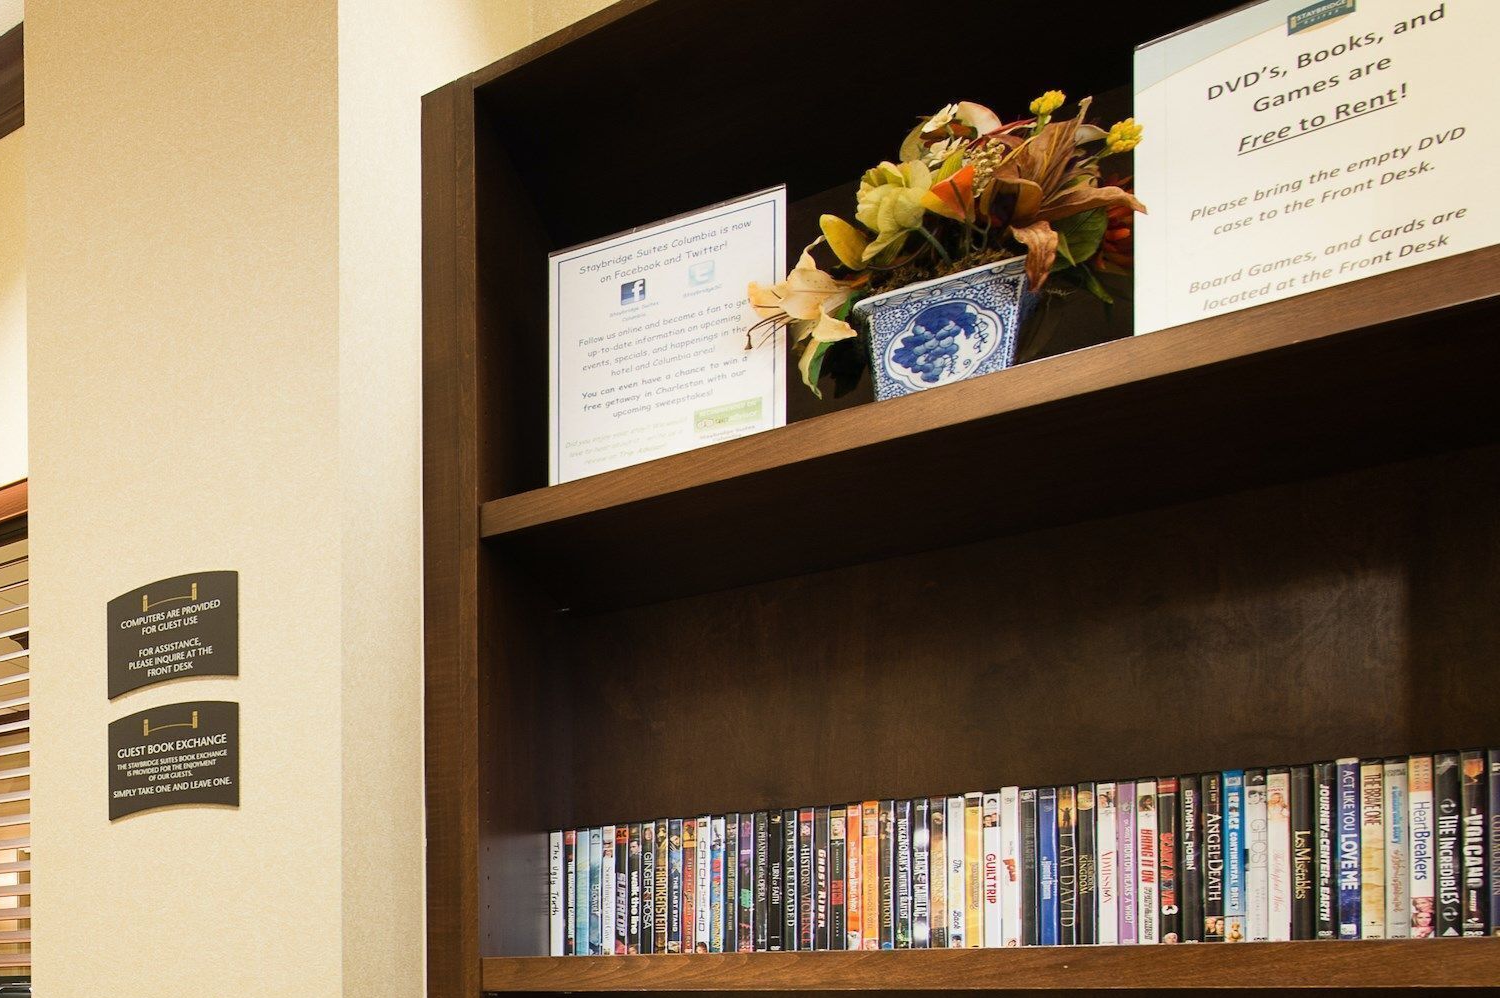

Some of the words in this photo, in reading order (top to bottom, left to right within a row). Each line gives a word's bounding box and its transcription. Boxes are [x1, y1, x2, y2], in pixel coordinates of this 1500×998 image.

[1207, 67, 1288, 101] DVD's,
[1298, 32, 1383, 69] Books,
[1394, 3, 1445, 35] and
[1253, 76, 1340, 112] Games
[1349, 56, 1392, 80] are
[1238, 126, 1291, 152] Free
[1299, 115, 1325, 131] to
[1335, 83, 1408, 120] Rent!
[1191, 196, 1248, 221] Please
[1254, 178, 1302, 202] bring
[1309, 167, 1340, 184] the
[1346, 144, 1412, 173] empty
[1418, 127, 1466, 151] DVD
[1213, 216, 1252, 235] case
[1259, 208, 1277, 221] to
[1284, 198, 1315, 214] the
[1321, 178, 1373, 203] Front
[1380, 165, 1435, 186] Desk.
[579, 253, 633, 275] Staybridge
[637, 244, 668, 257] Suites
[672, 229, 716, 247] Columbia
[720, 226, 728, 234] is
[732, 221, 751, 231] now
[600, 275, 611, 283] on
[615, 260, 660, 279] Facebook
[664, 254, 681, 265] and
[686, 241, 727, 260] Twitter!
[1189, 269, 1242, 294] Board
[1248, 251, 1316, 277] Games,
[1324, 236, 1362, 256] and
[1369, 219, 1424, 243] Cards
[1432, 207, 1467, 225] are
[1203, 283, 1270, 311] located
[1277, 277, 1295, 289] at
[1302, 266, 1331, 283] the
[1339, 251, 1393, 274] Front
[1398, 235, 1448, 257] Desk
[582, 390, 597, 399] You
[601, 387, 615, 395] can
[619, 382, 637, 391] even
[642, 375, 662, 386] have
[675, 366, 705, 377] chance
[583, 403, 601, 412] free
[605, 396, 640, 408] getaway
[656, 379, 703, 394] Charleston
[613, 405, 651, 418] upcoming
[655, 389, 713, 408] sweepstakes!
[121, 612, 166, 629] COMPUTERS
[167, 608, 181, 618] ARE
[182, 599, 220, 615] PROVIDED
[142, 625, 156, 635] FOR
[158, 618, 182, 631] GUEST
[184, 616, 198, 625] USE
[129, 658, 153, 670] PLEASE
[155, 652, 185, 664] INQUIRE
[186, 648, 196, 658] AT
[198, 646, 213, 655] THE
[139, 647, 153, 657] FOR
[155, 637, 201, 654] ASSISTANCE,
[148, 667, 171, 677] FRONT
[174, 662, 193, 672] DESK
[118, 746, 145, 758] GUEST
[148, 742, 175, 754] BOOK
[177, 734, 227, 750] EXCHANGE
[128, 759, 159, 769] STAYBRIDGE
[197, 750, 227, 758] EXCHANGE
[133, 767, 159, 776] PROVIDED
[184, 759, 216, 769] ENJOYMENT
[1343, 771, 1354, 788] ACT
[113, 788, 136, 799] SIMPLY
[138, 787, 154, 795] TAKE
[156, 784, 171, 793] ONE
[173, 782, 189, 791] AND
[191, 779, 212, 789] LEAVE
[213, 777, 232, 786] ONE.
[1343, 791, 1354, 808] LIKE
[1185, 790, 1193, 831] BATMAN
[1320, 784, 1330, 831] JOURNEY
[1344, 811, 1355, 830] YOU
[1440, 815, 1458, 835] THE
[1207, 813, 1221, 857] ANGEL
[1341, 833, 1358, 868] LOVE
[1413, 802, 1431, 880] HeartBreakers
[1464, 814, 1483, 888] VOLCANO
[643, 852, 653, 893] GINGER
[818, 849, 826, 886] GHOST
[986, 854, 996, 881] GUILT
[1184, 841, 1196, 870] ROBIN
[1320, 839, 1329, 878] CENTER
[1440, 838, 1459, 904] INCREDIBLES
[550, 866, 559, 885] Ugly
[1208, 858, 1223, 901] DEATH
[1341, 871, 1358, 890] ME
[616, 873, 626, 936] SUPERCOP
[787, 867, 795, 926] RELOADED
[818, 891, 826, 928] RIDER
[987, 885, 996, 903] TRIP
[1061, 875, 1074, 927] DAVID
[1320, 887, 1330, 921] EARTH
[643, 899, 652, 928] ROSA
